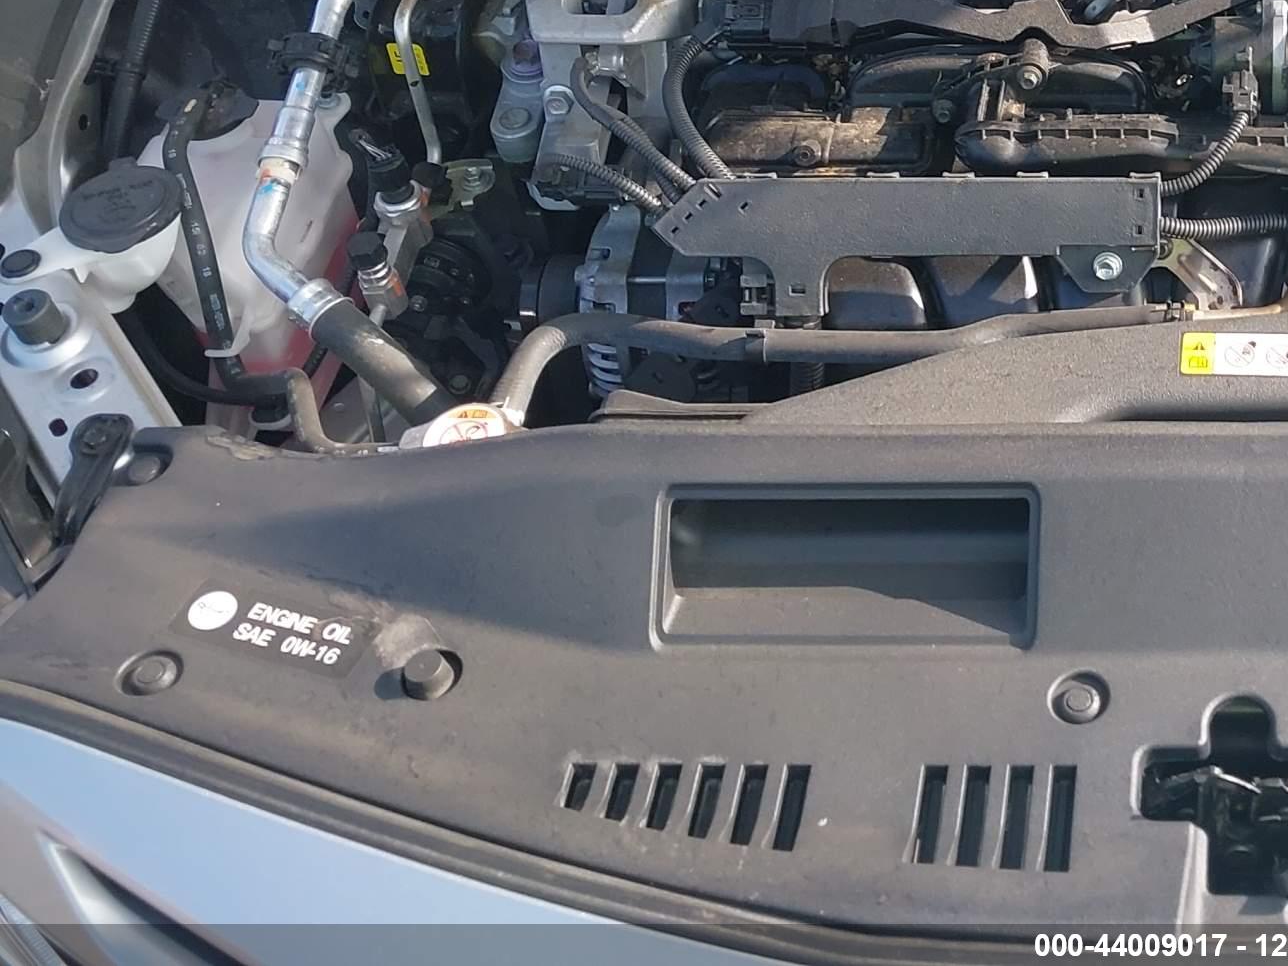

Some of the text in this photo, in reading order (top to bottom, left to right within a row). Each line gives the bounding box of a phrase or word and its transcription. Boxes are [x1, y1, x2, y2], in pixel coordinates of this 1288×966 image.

[233, 623, 341, 665] SAE 0W-16
[247, 602, 352, 645] ENGINE OIL
